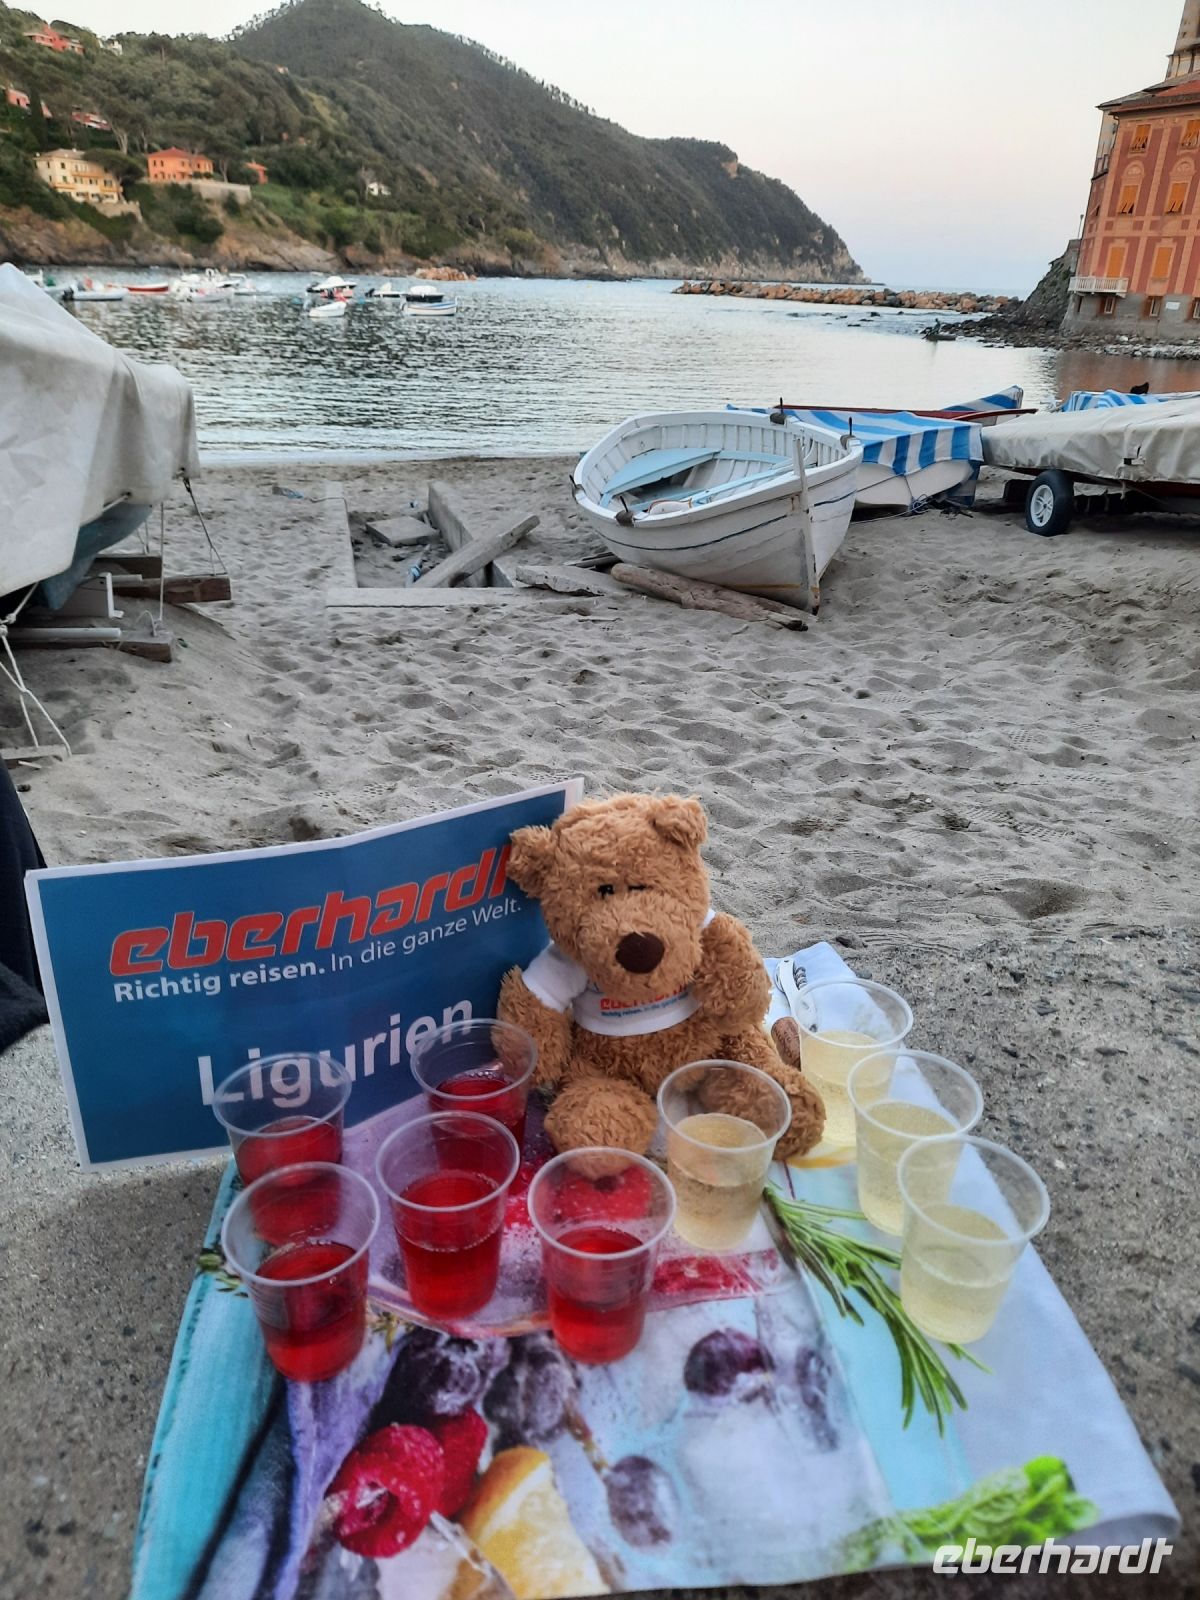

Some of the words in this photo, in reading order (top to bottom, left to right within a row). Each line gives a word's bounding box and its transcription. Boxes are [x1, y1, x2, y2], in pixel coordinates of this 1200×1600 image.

[114, 972, 220, 1003] Richtig
[230, 960, 325, 988] reisen.
[331, 953, 352, 972] In
[361, 941, 396, 963] die
[402, 917, 467, 955] ganze
[472, 898, 521, 926] Welt.
[198, 1000, 473, 1108] Ligurien
